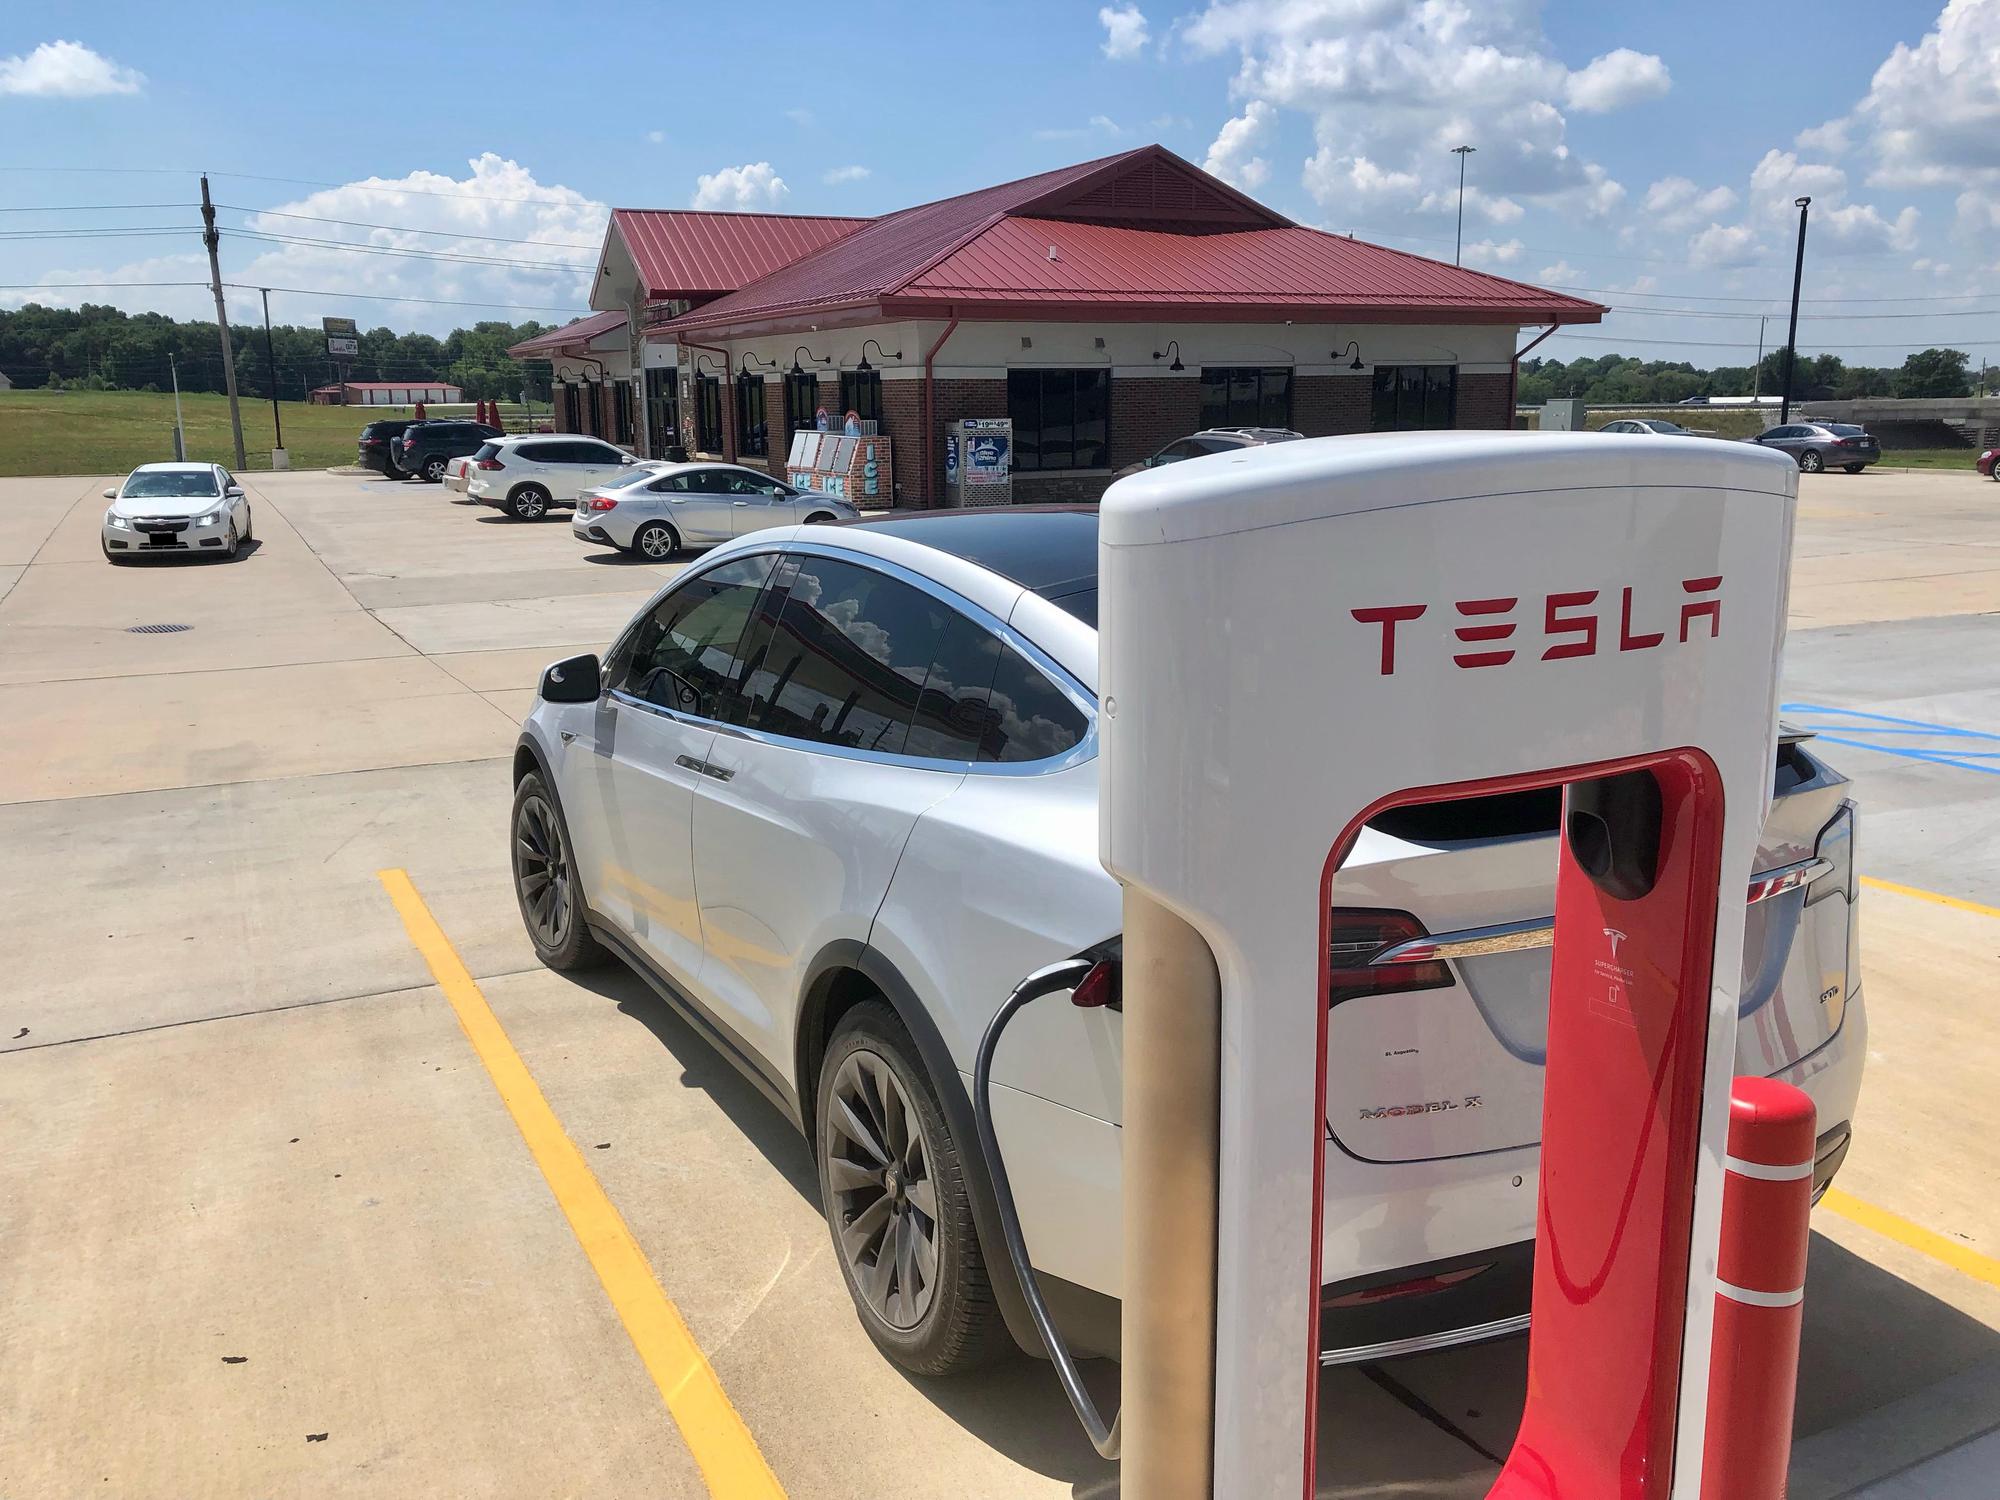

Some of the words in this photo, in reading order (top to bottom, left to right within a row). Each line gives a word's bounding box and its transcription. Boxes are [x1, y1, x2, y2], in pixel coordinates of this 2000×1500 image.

[793, 471, 811, 490] ICE
[864, 443, 879, 495] ICE
[822, 475, 844, 498] ICE
[1350, 576, 1723, 676] TESLA
[1594, 959, 1634, 978] SUPERCHARGER
[1359, 1100, 1458, 1120] MODEL
[1464, 1095, 1483, 1109] X
